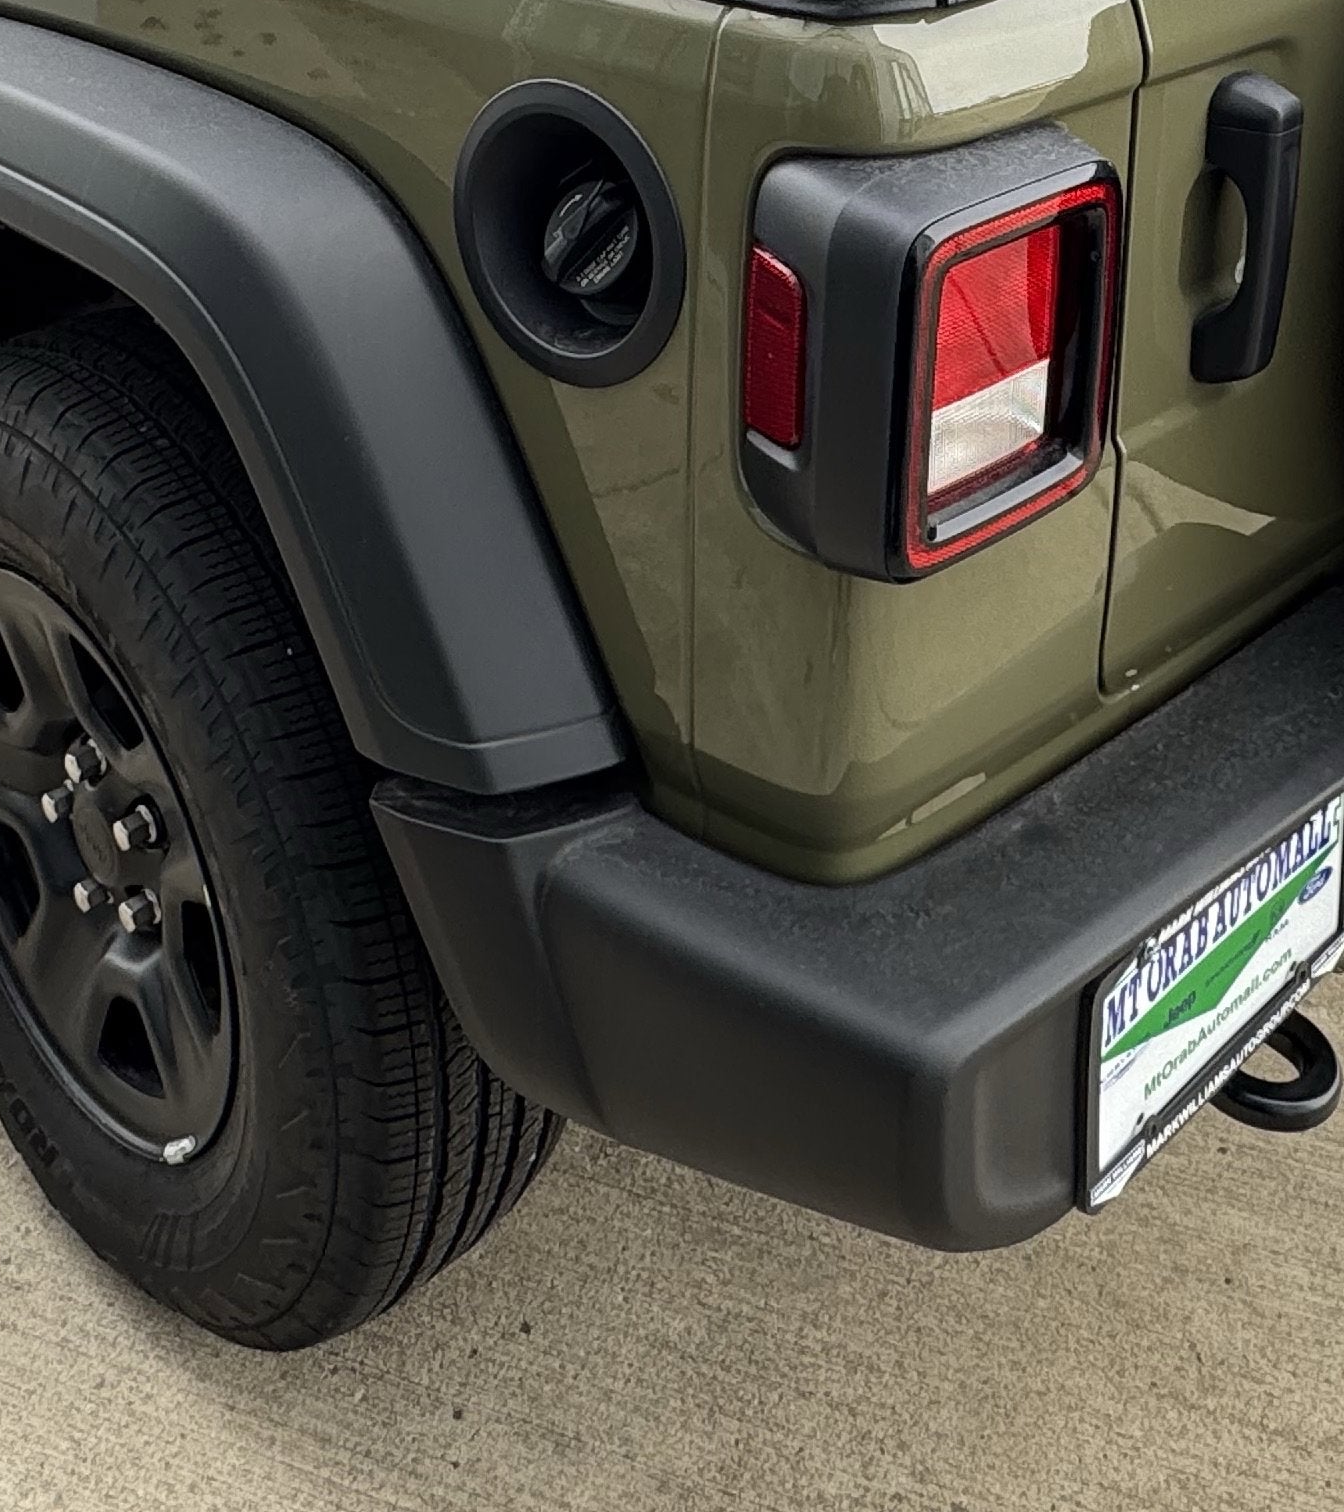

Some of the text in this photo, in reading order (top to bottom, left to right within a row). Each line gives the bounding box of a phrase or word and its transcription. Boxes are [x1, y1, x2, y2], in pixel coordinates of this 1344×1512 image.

[1105, 973, 1143, 1048] MT
[1147, 918, 1209, 1002] ORAB
[1212, 806, 1333, 943] AUTOMALL
[1143, 947, 1293, 1101] MtOrabAutomall.com
[1163, 990, 1197, 1027] Jeep
